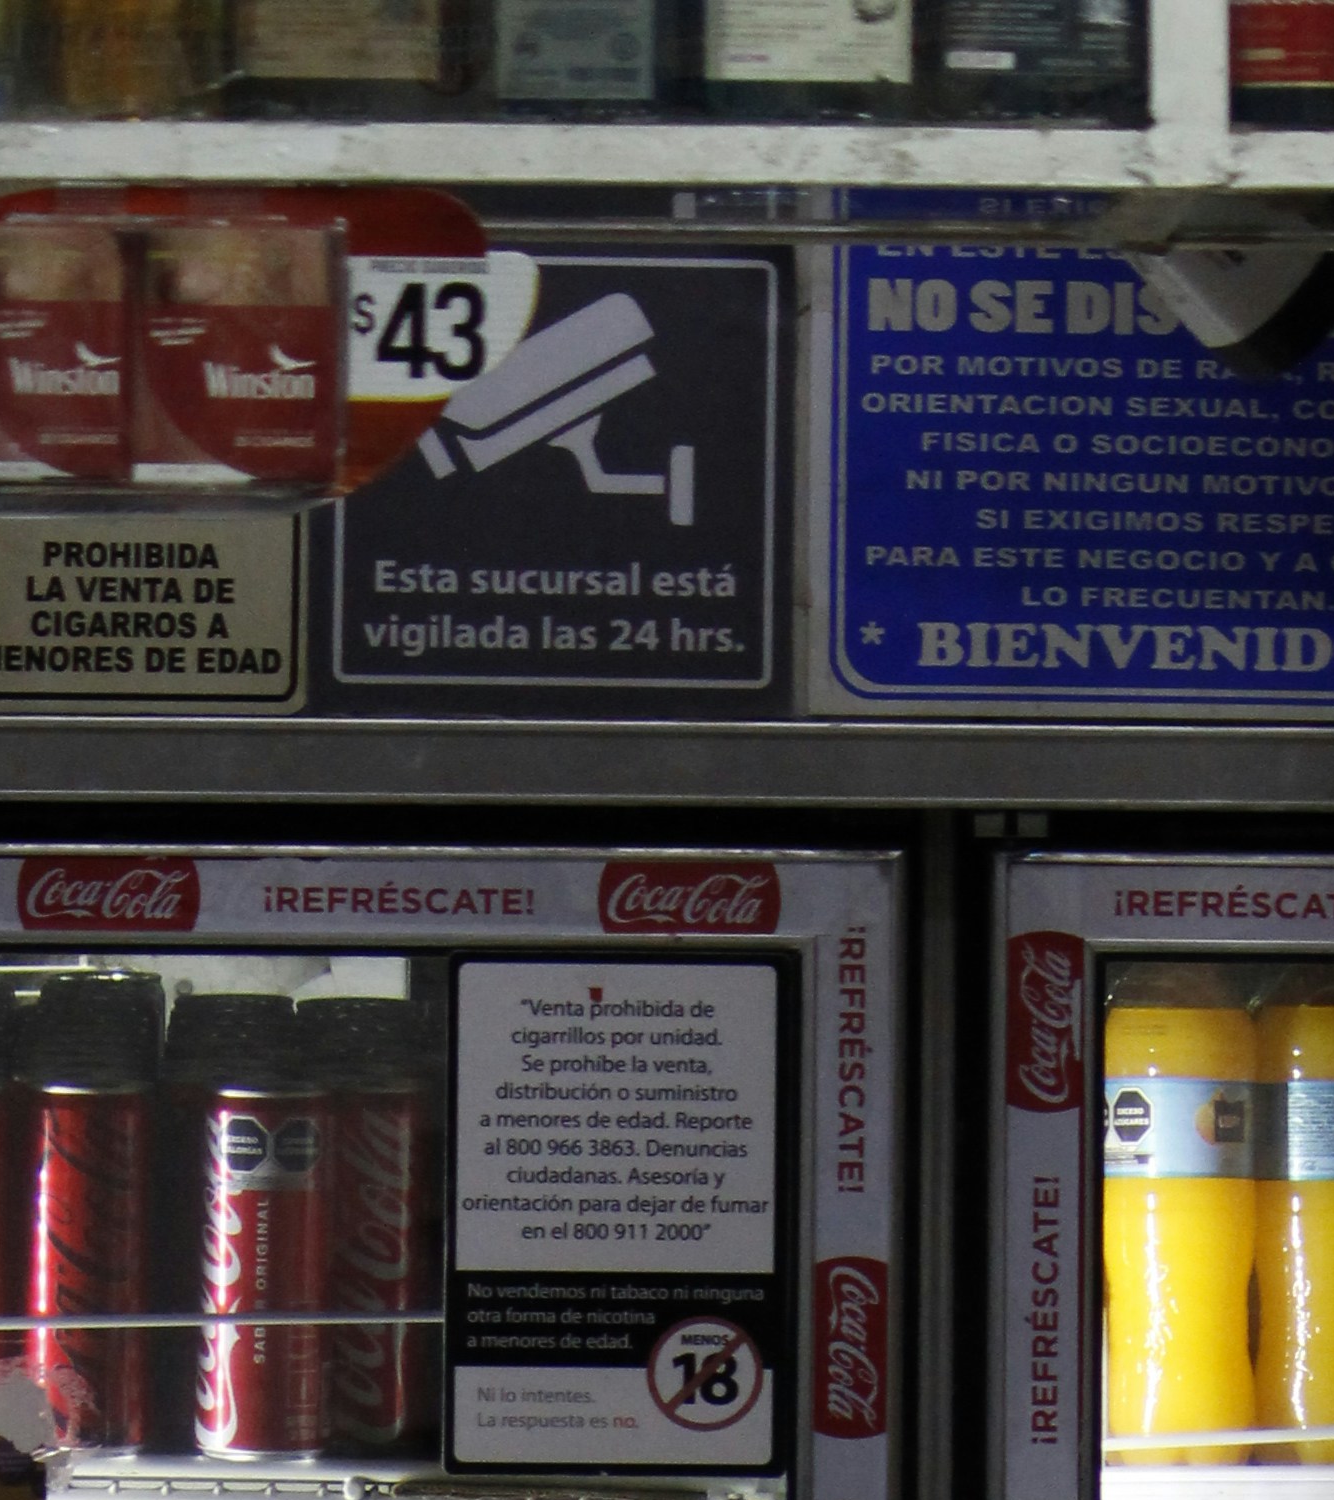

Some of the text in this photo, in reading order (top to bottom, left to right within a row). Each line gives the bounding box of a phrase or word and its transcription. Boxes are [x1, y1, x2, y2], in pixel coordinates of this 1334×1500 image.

[868, 279, 957, 331] NO
[970, 281, 1054, 334] SE
[9, 355, 120, 396] Winston
[205, 359, 316, 400] Winston
[872, 357, 944, 377] POR
[958, 358, 1124, 379] MOTIVOS
[1137, 359, 1182, 379] DE
[862, 393, 1113, 415] ORIENTACION
[1125, 397, 1279, 420] SEXUAL,
[921, 432, 1039, 453] FISICA
[1053, 434, 1077, 453] O
[905, 470, 942, 490] NI
[957, 472, 1029, 491] POR
[1044, 473, 1187, 493] NINGUN
[977, 509, 1008, 529] SI
[1024, 510, 1202, 532] EXIGIMOS
[43, 543, 218, 569] PROHIBIDA
[867, 546, 960, 567] PARA
[975, 548, 1064, 568] ESTE
[1078, 550, 1246, 571] NEGOCIO
[1259, 552, 1284, 572] Y
[1295, 553, 1319, 573] A
[27, 577, 234, 603] LA VENTA DE
[375, 560, 734, 596] Esta sucursal está
[1021, 586, 1065, 606] LO
[32, 612, 228, 638] CIGARROS A
[365, 616, 744, 656] vigilada las 24 hrs.
[146, 647, 185, 673] DE
[198, 648, 282, 675] EDAD
[26, 867, 181, 920] Coca-Cola
[265, 882, 535, 916] ¡REFRÉSCATE!
[590, 1001, 683, 1020] prohibida
[691, 1001, 713, 1017] de
[512, 1027, 721, 1048] cigarrillos por unidad.
[522, 1055, 543, 1072] Se
[632, 1056, 647, 1072] la
[837, 927, 871, 1194] ¡REFRÉSCATE!
[496, 1083, 737, 1102] distribución o suministro
[480, 1112, 752, 1132] a menores de edad. Reporte
[484, 1139, 500, 1155] al
[507, 1139, 540, 1155] 800
[548, 1140, 582, 1156] 966
[646, 1141, 747, 1157] Denuncias
[507, 1167, 724, 1189] ciudadanas. Asesoría y
[463, 1195, 768, 1216] orientación para dejar de fumar
[522, 1227, 544, 1238] en
[551, 1223, 567, 1238] el
[574, 1224, 608, 1239] 800
[616, 1224, 647, 1239] 911
[825, 1264, 878, 1428] Coca-Cola
[672, 1352, 738, 1405] 18
